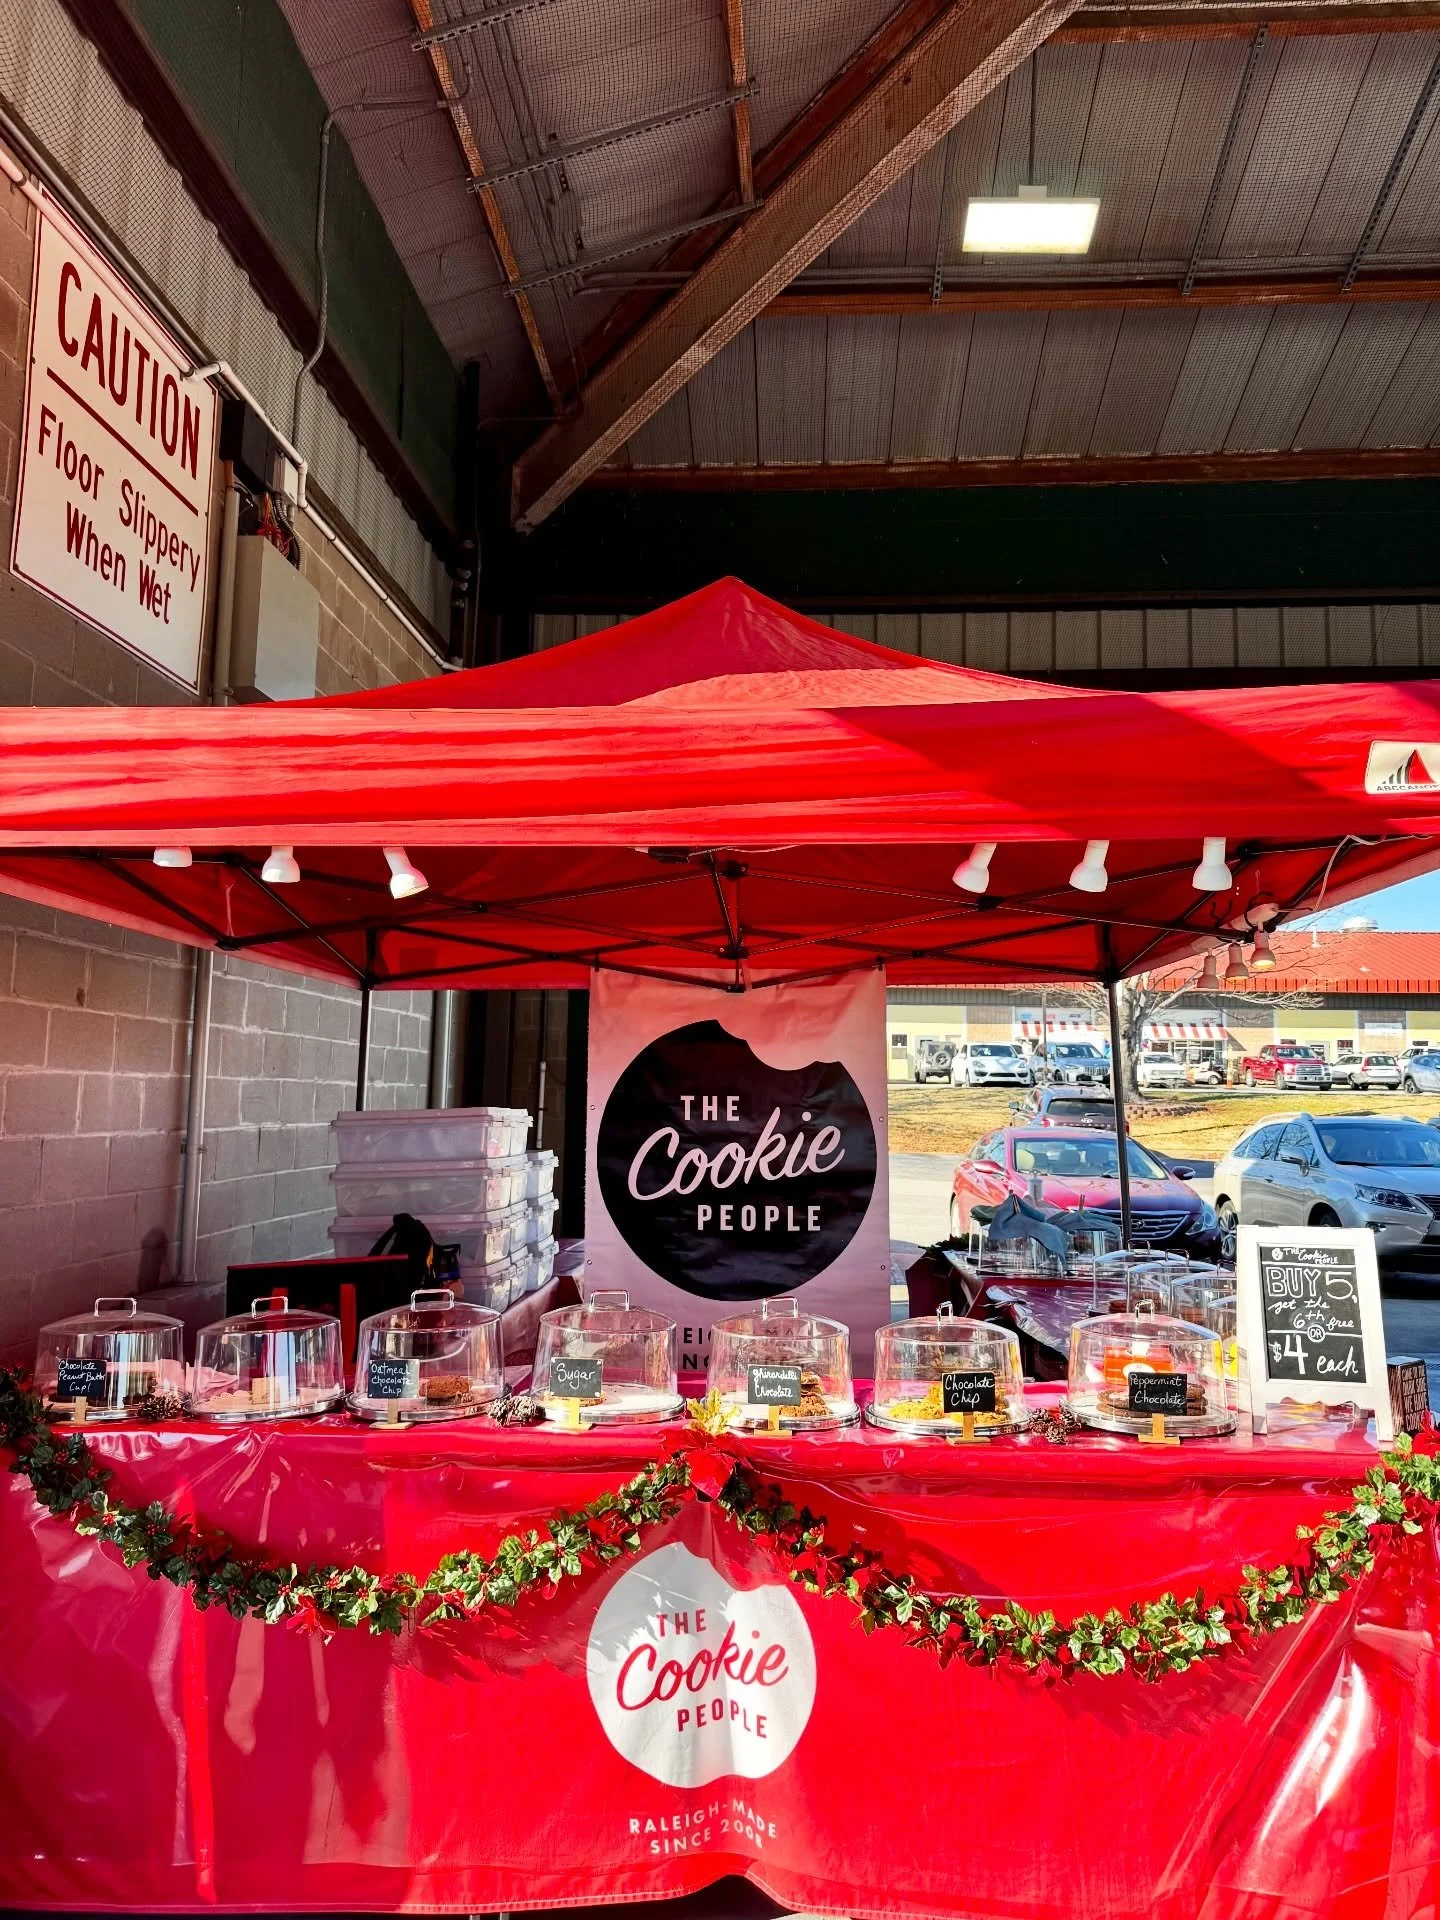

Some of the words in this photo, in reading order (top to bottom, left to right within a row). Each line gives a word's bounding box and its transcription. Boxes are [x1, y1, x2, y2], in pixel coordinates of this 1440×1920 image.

[57, 261, 200, 481] CAUTION
[38, 403, 104, 501] Floor
[119, 478, 200, 592] Slippery
[66, 500, 126, 593] When
[138, 558, 171, 625] Wet
[680, 1095, 740, 1122] THE
[627, 1106, 847, 1201] Cookie
[697, 1204, 821, 1232] PEOPLE
[1283, 1247, 1300, 1256] THE
[1298, 1249, 1329, 1261] Cookie
[1314, 1256, 1339, 1265] PEOPLE
[1266, 1266, 1321, 1298] BUY
[1268, 1299, 1296, 1314] get
[1304, 1297, 1330, 1309] the
[1293, 1310, 1325, 1329] 6th
[1326, 1316, 1355, 1331] free
[58, 1360, 97, 1371] Chocolate
[371, 1362, 412, 1375] Oatmeal
[1268, 1334, 1308, 1375] $4
[1317, 1345, 1359, 1377] each
[59, 1370, 85, 1382] Peanut
[371, 1375, 414, 1387] Chocolate
[557, 1362, 596, 1390] Sugar
[945, 1374, 996, 1391] Chocolate
[1129, 1373, 1182, 1389] Peppermint
[382, 1386, 402, 1396] Chip
[951, 1390, 980, 1409] Chip
[1134, 1389, 1186, 1406] Chocolate
[656, 1608, 707, 1637] THE
[616, 1619, 789, 1711] Cookie
[677, 1698, 768, 1739] PEOPLE
[629, 1798, 777, 1839] RALEIGH-MADE
[650, 1827, 712, 1855] SINCE
[720, 1818, 764, 1849] 2008
